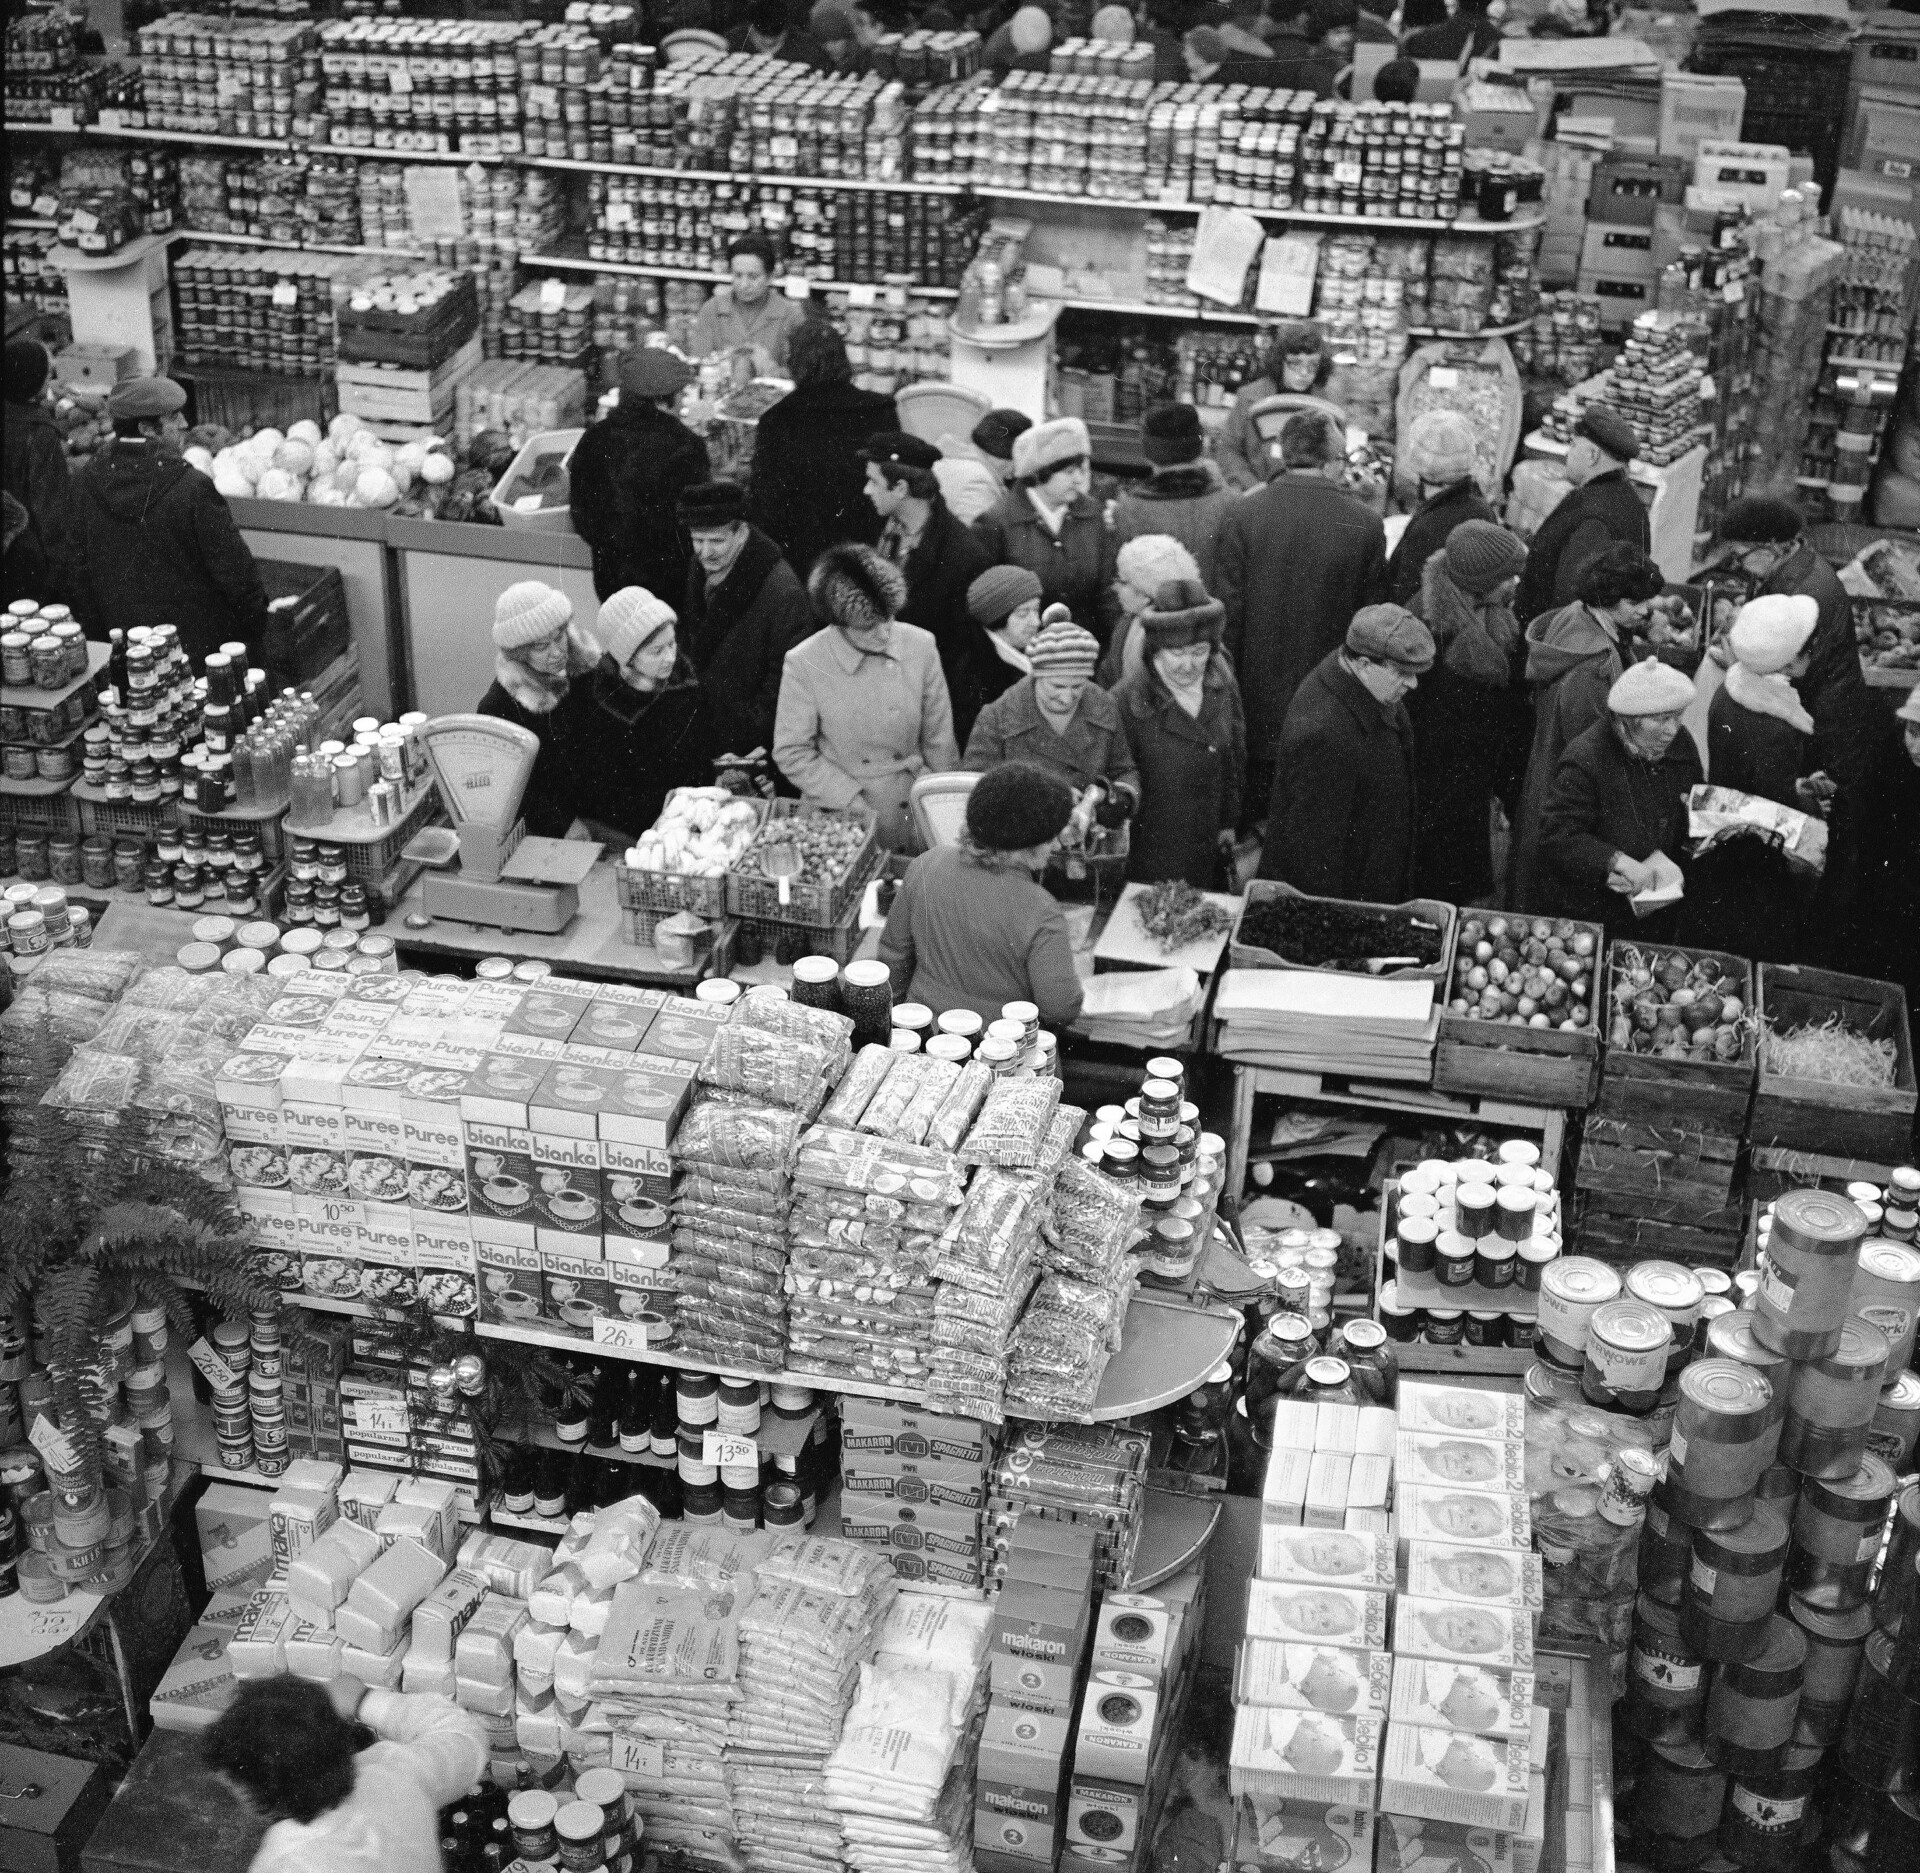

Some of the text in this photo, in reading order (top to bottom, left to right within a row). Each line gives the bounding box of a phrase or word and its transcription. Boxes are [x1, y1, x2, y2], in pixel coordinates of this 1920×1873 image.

[534, 978, 594, 996] bianka
[599, 987, 659, 1006] bianka
[666, 1000, 726, 1019] bianka
[495, 1038, 556, 1058] bianka
[563, 1047, 624, 1067] bianka
[630, 1055, 692, 1076] bianka
[467, 1122, 529, 1150] bianka
[533, 1137, 597, 1166] bianka
[605, 1143, 669, 1174] bianka
[479, 1242, 539, 1270] bianka
[545, 1252, 605, 1277] bianka
[349, 1430, 401, 1443] popularna
[845, 1436, 893, 1450] MAKARON
[932, 1442, 982, 1462] SPAGHETTI
[847, 1476, 893, 1491] MAKARON
[932, 1484, 980, 1508] SPAGHETTI
[844, 1524, 889, 1539] MAKARON
[926, 1532, 976, 1557] SPAGHETTI
[928, 1561, 976, 1583] SPAGHETTI
[1002, 1631, 1066, 1655] makaron
[1369, 1651, 1391, 1701] Bebiko
[1511, 1673, 1532, 1722] Bebiko
[1088, 1735, 1139, 1751] MAKARON
[1355, 1714, 1378, 1763] Bebiko
[1508, 1740, 1528, 1782] Bebiko
[984, 1791, 1049, 1816] makaron
[1079, 1788, 1128, 1805] MAKARON
